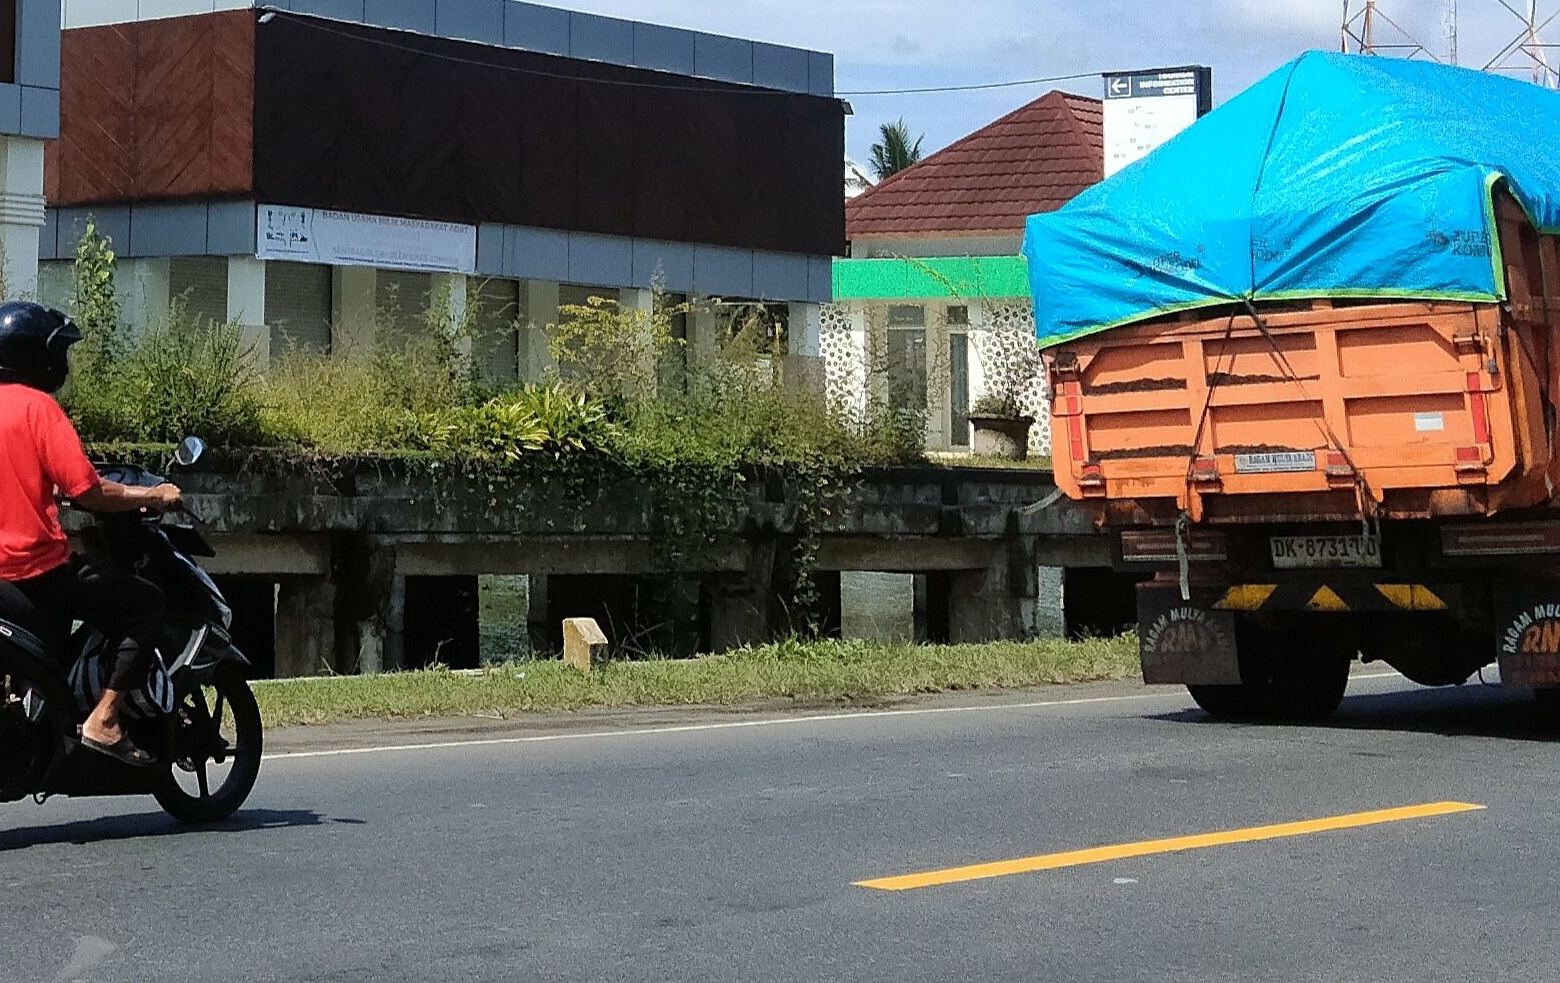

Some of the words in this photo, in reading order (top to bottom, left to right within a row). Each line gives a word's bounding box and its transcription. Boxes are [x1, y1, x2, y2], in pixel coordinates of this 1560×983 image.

[1139, 78, 1194, 88] INFORMATION
[322, 210, 350, 222] BADAN
[1273, 538, 1297, 558] DK
[1306, 538, 1350, 558] 8731
[1144, 614, 1170, 653] RAGAM
[1170, 606, 1206, 624] MULYA
[1502, 611, 1533, 654] RAGAM
